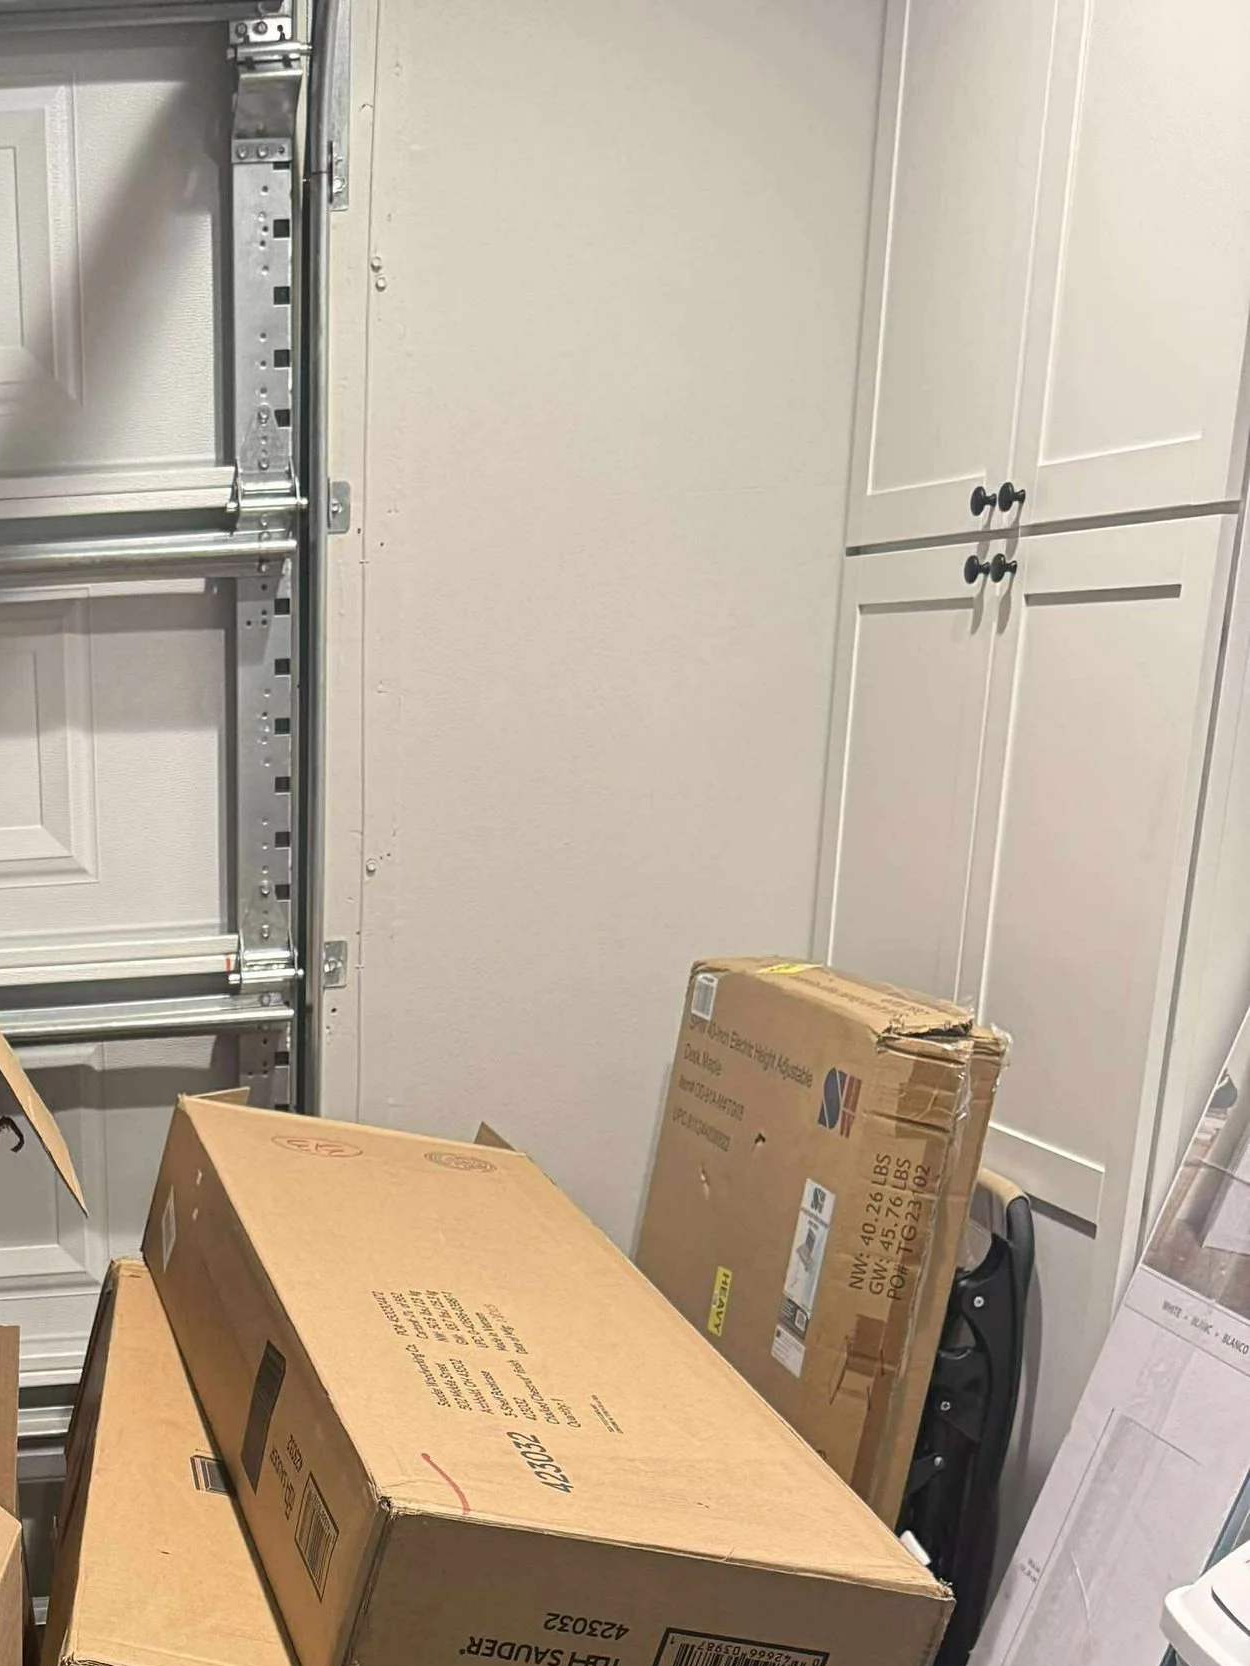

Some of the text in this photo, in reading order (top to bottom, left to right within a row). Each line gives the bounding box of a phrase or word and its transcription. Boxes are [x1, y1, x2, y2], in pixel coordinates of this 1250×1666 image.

[729, 1031, 754, 1059] Electric
[753, 1042, 776, 1072] Height
[776, 1053, 813, 1088] Adjustable
[849, 1153, 891, 1290] NW: 40.26 LBS
[869, 1159, 911, 1296] GW: 45.76 LBS
[711, 1272, 730, 1333] HEAVY
[887, 1263, 910, 1300] PO#
[1222, 1334, 1249, 1355] BLANCO
[434, 1362, 454, 1380] Street
[454, 1397, 473, 1411] 502
[507, 1431, 574, 1494] 423032
[544, 1612, 630, 1641] 423032
